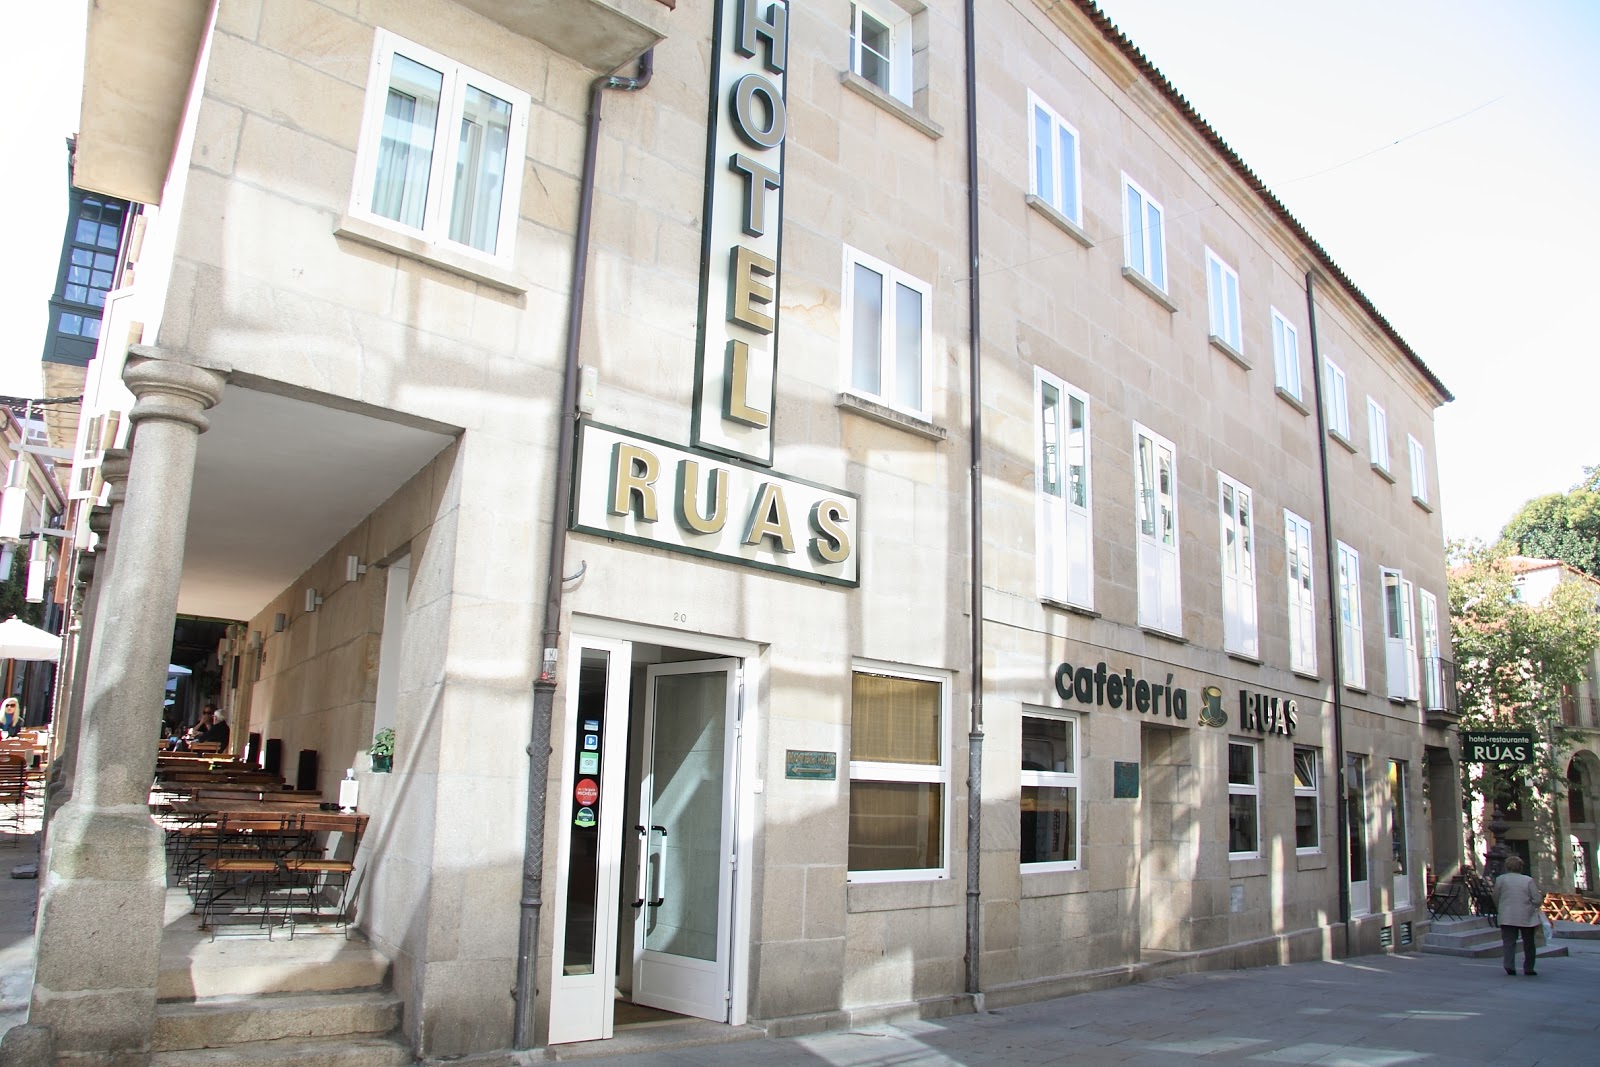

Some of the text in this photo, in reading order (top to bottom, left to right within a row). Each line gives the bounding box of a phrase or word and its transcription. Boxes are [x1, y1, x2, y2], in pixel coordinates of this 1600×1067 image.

[722, 0, 787, 430] HOTEL
[608, 442, 850, 563] RUAS
[673, 611, 687, 623] 20
[1055, 662, 1299, 736] cafetería RUAS
[1468, 735, 1530, 744] hotel-restaurante
[1474, 744, 1526, 761] RÚAS
